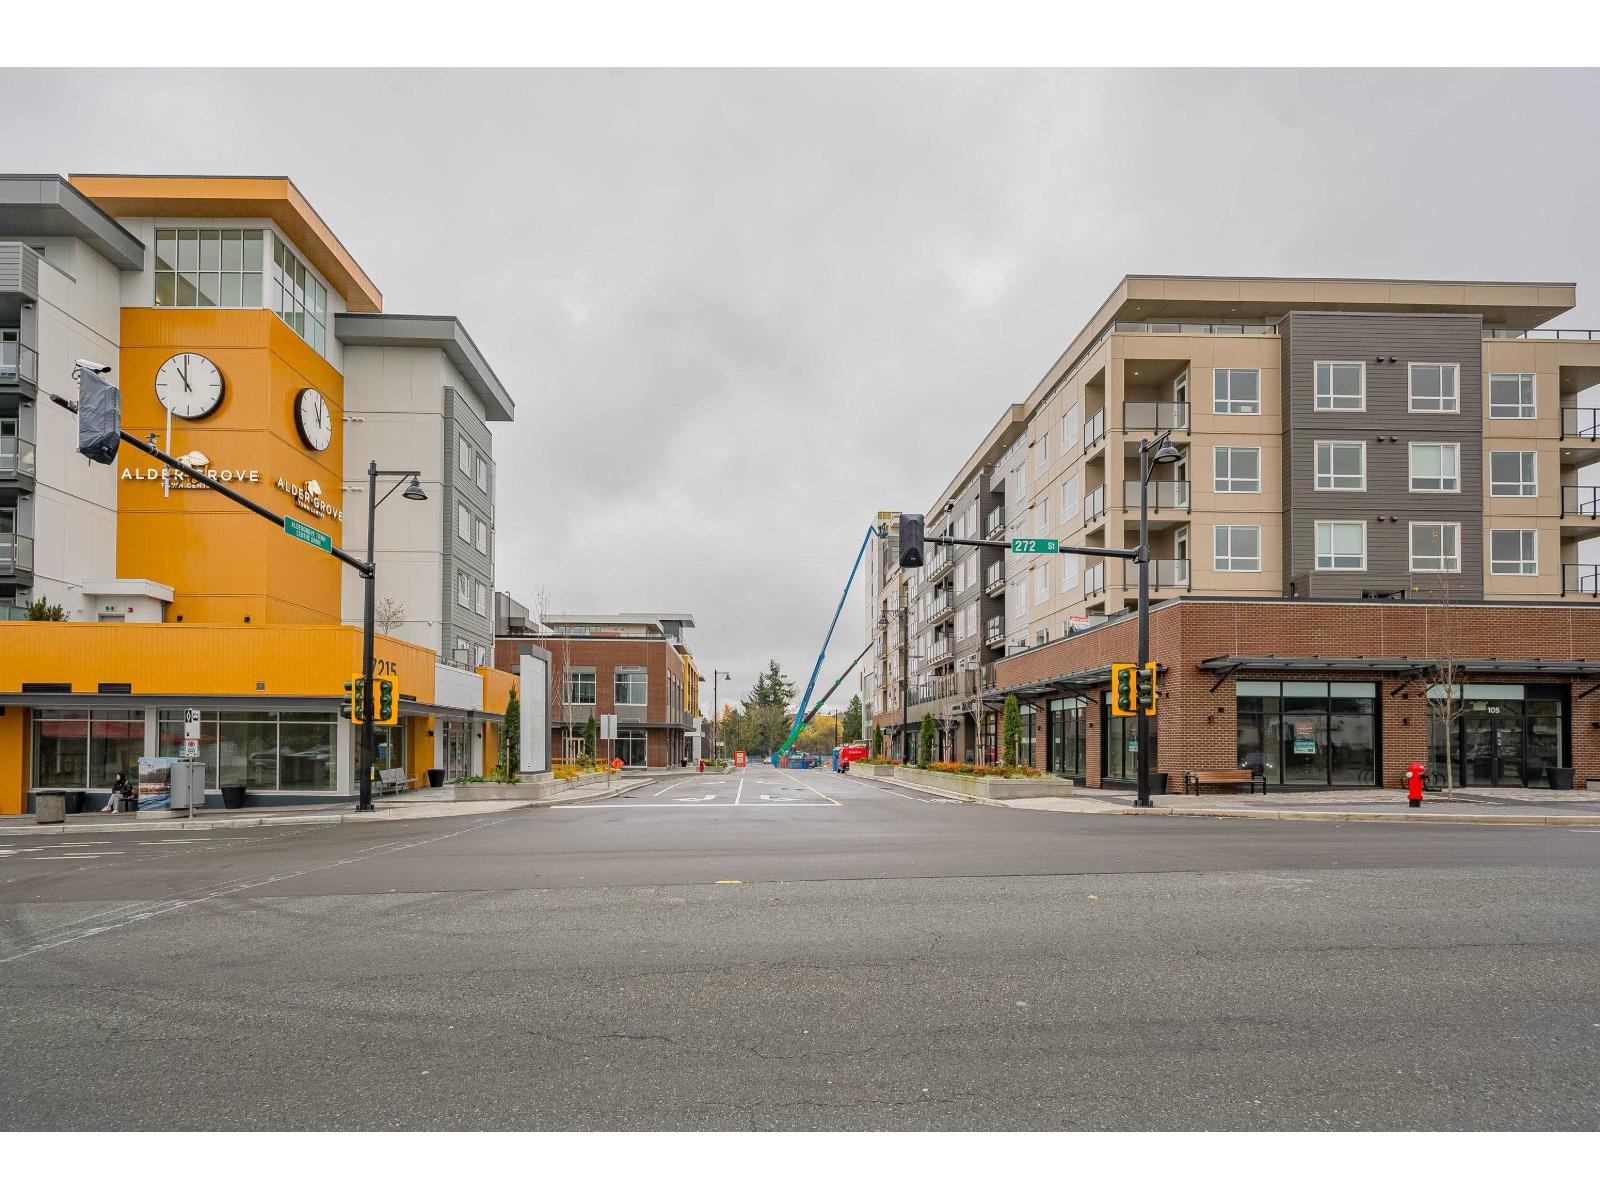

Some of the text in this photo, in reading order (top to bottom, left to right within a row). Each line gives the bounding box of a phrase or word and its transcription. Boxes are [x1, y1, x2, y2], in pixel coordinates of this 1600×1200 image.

[1015, 540, 1055, 552] 272 St
[1488, 706, 1500, 714] 105
